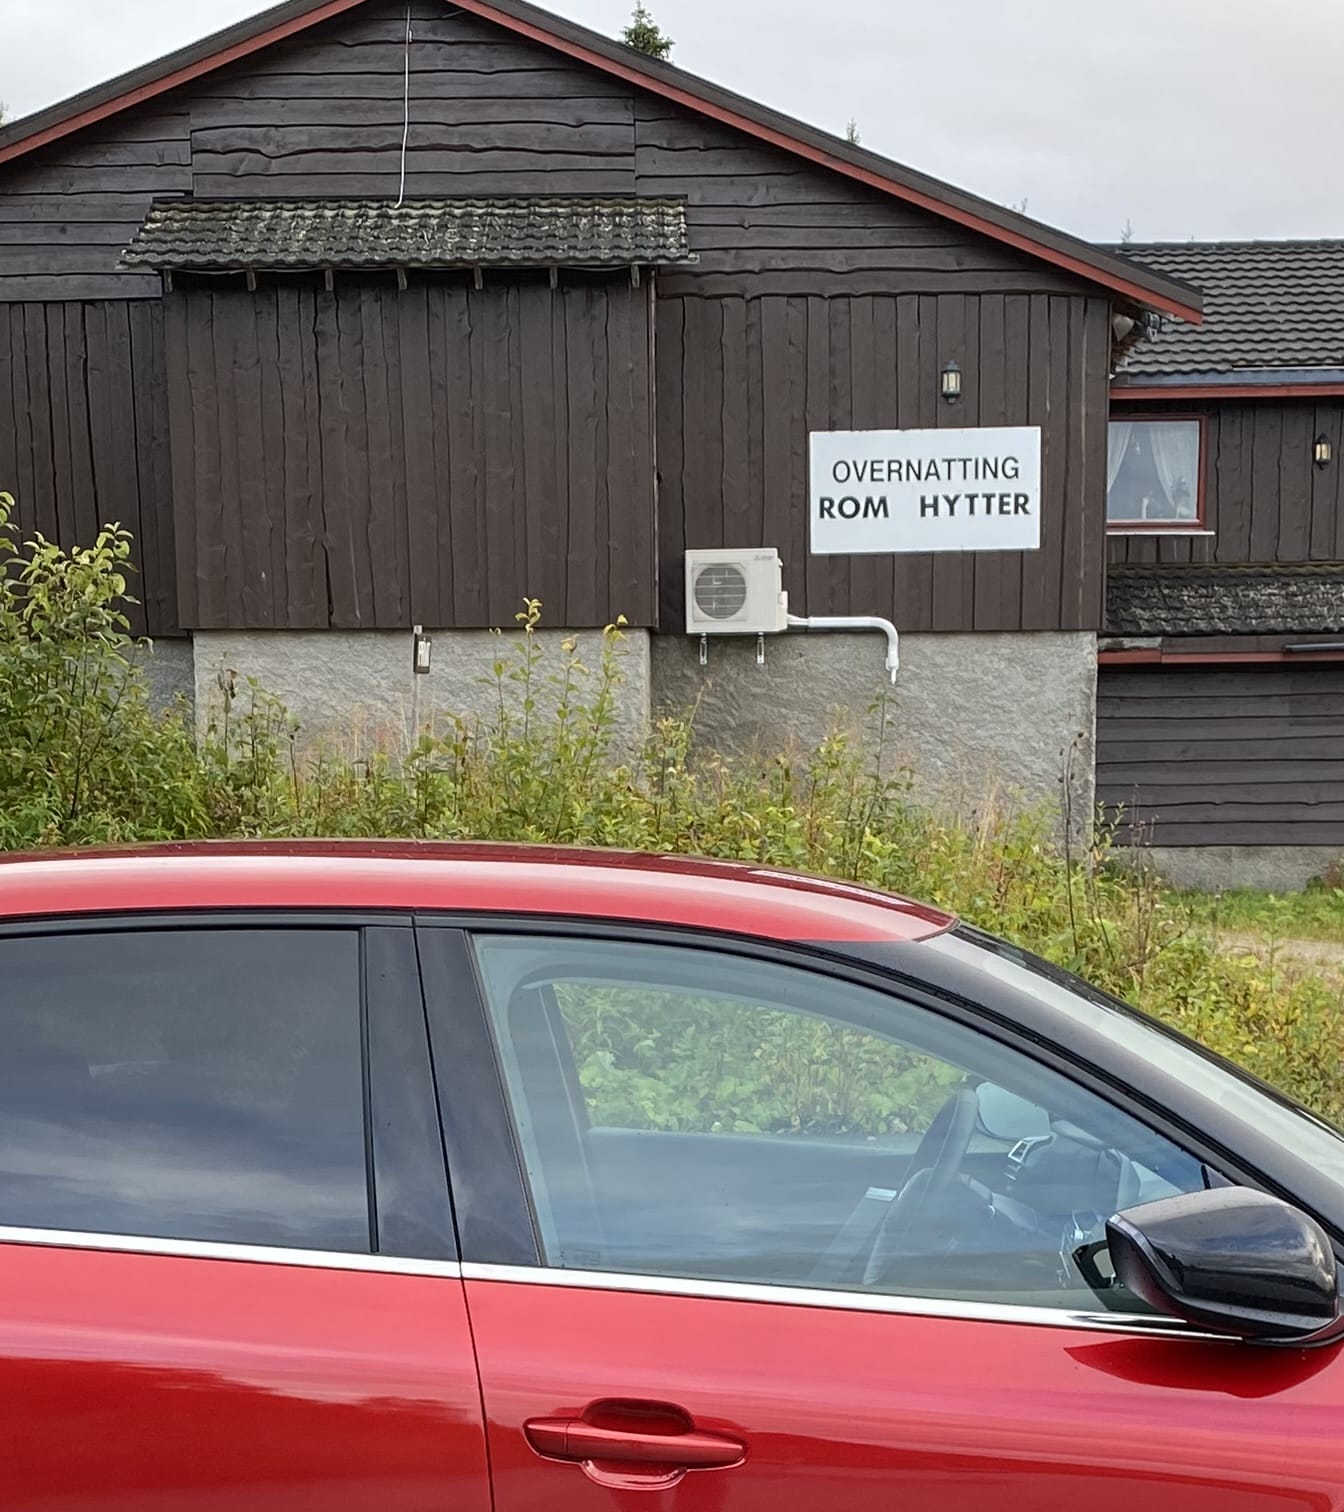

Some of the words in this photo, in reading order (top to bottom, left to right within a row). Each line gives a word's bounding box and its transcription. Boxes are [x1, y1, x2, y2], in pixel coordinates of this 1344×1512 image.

[832, 456, 1020, 483] OVERNATTING
[819, 495, 890, 519] ROM
[919, 493, 1032, 517] HYTTER
